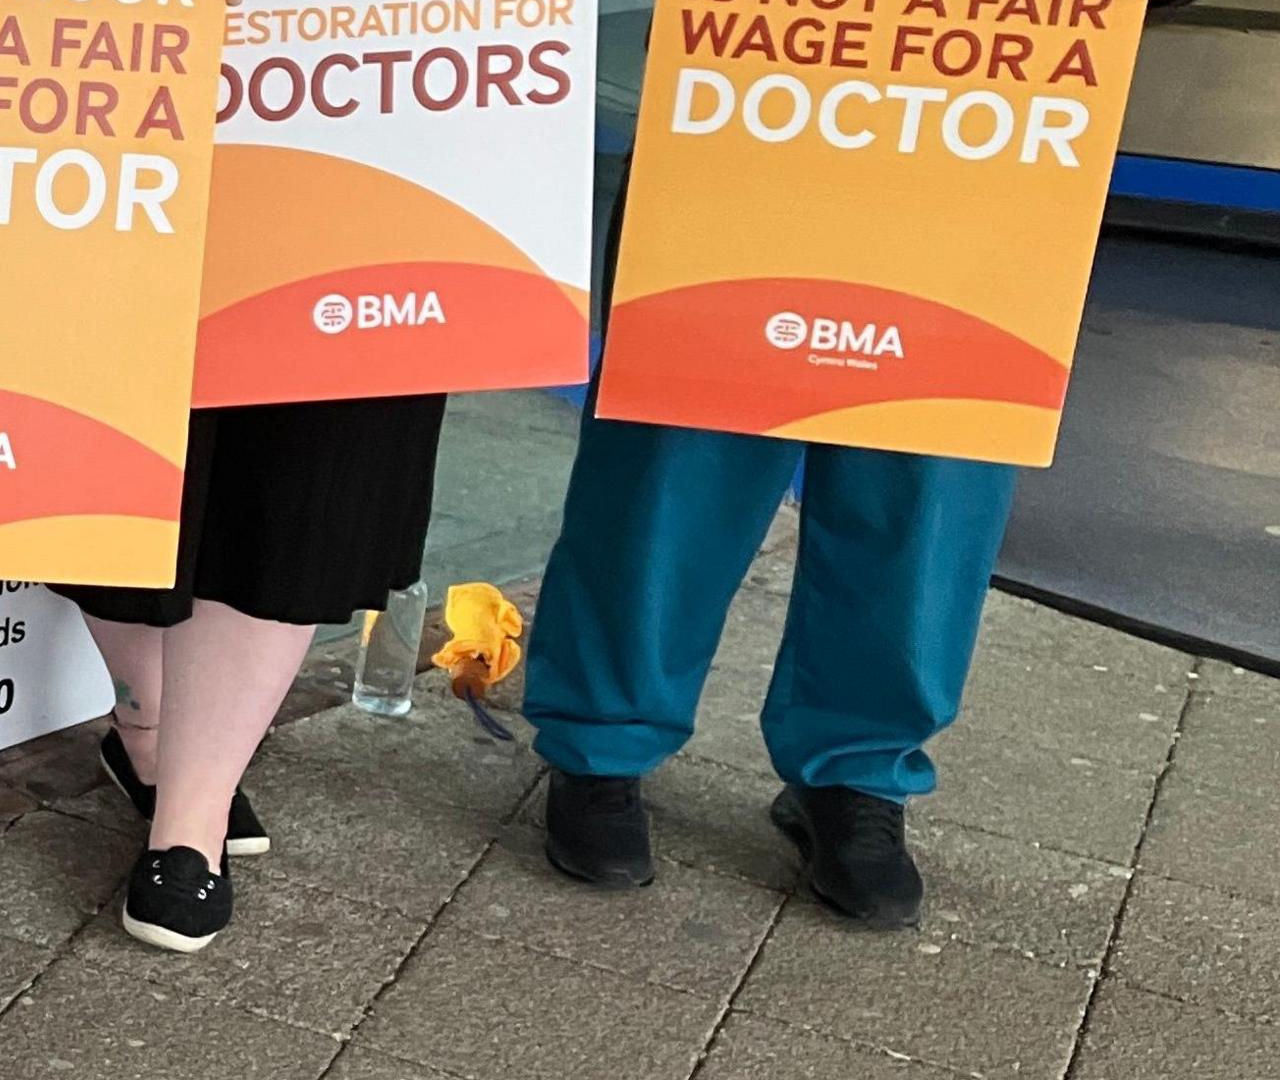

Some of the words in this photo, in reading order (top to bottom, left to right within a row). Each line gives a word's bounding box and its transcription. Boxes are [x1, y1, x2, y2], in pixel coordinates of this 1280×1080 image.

[51, 18, 190, 75] FAIR
[681, 8, 872, 70] WAGE
[891, 25, 1034, 82] FOR
[1047, 39, 1098, 87] A
[135, 85, 186, 141] A
[671, 67, 1090, 169] DOCTOR
[357, 291, 446, 329] BMA
[810, 318, 904, 359] BMA
